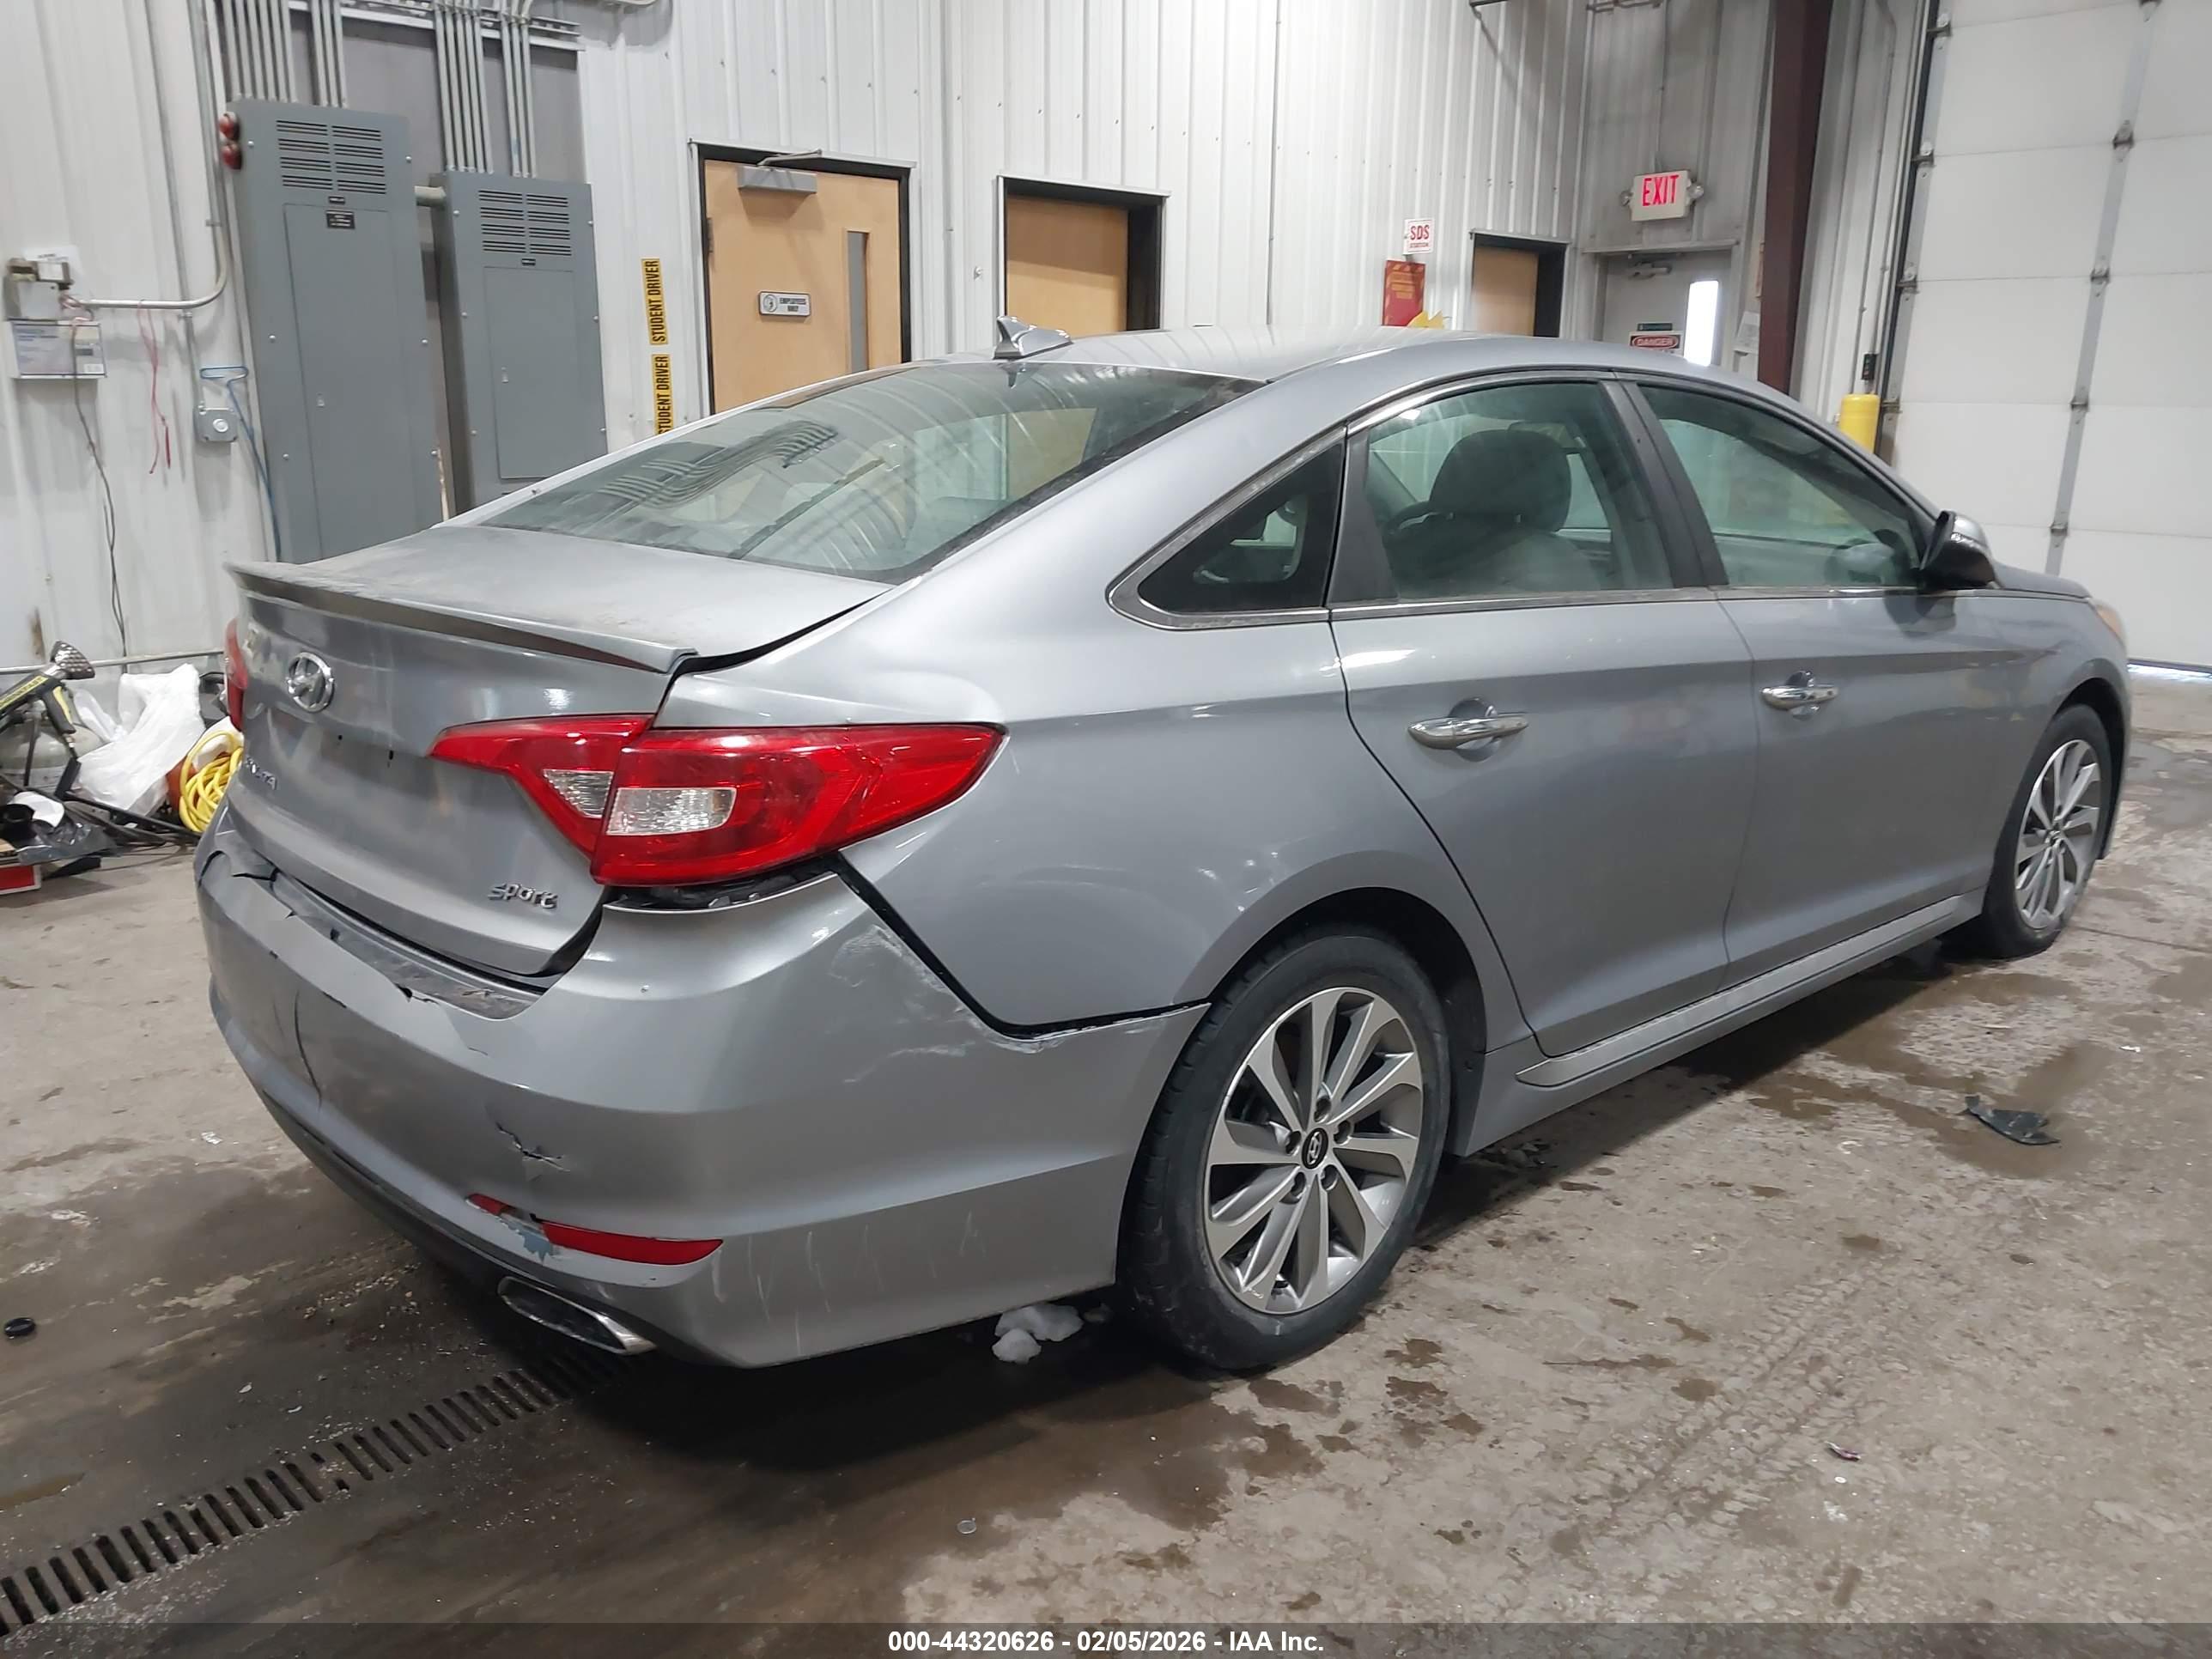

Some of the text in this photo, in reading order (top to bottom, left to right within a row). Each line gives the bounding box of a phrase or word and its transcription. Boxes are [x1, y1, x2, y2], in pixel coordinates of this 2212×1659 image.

[1643, 174, 1680, 207] EXIT
[1410, 224, 1431, 240] SDS
[645, 260, 665, 342] STUDENT DRIVER
[655, 356, 670, 391] DRIVER
